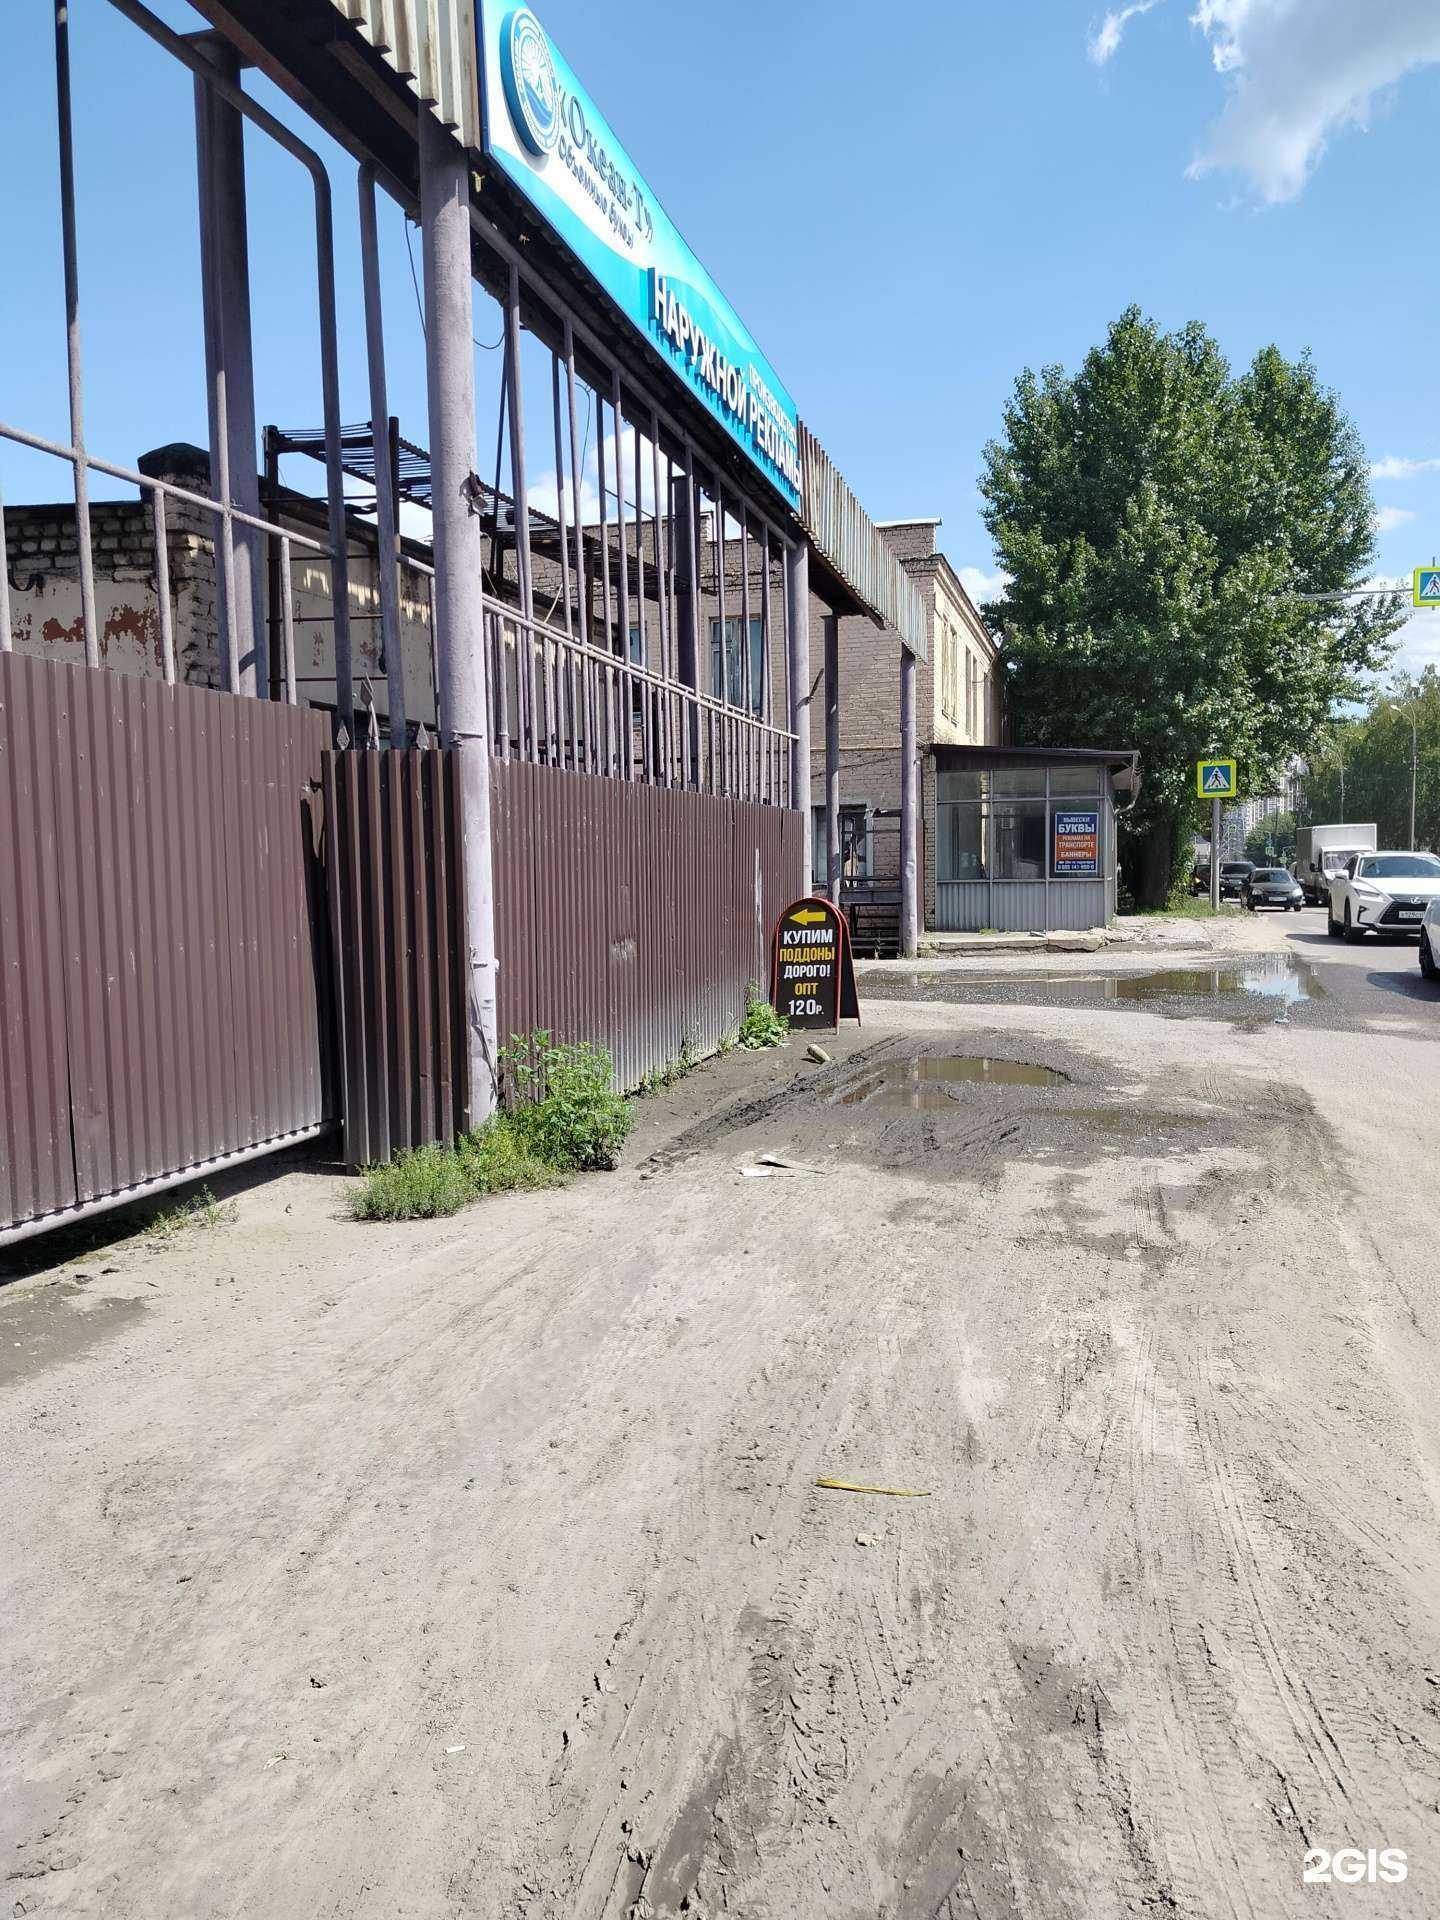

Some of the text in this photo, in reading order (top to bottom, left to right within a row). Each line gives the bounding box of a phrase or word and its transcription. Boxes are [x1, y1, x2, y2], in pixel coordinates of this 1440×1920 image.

[652, 268, 747, 423] НАРУЖНОЙ
[750, 392, 803, 496] РЕКЛАМЫ
[1058, 823, 1095, 834] БУКВЫ
[1058, 841, 1095, 849] ТРАНСПОРТЕ
[783, 929, 833, 945] КУПИМ
[780, 947, 835, 963] ПОДДОНЫ
[783, 965, 830, 979] ДОРОГО!
[795, 982, 818, 996] ОПТ
